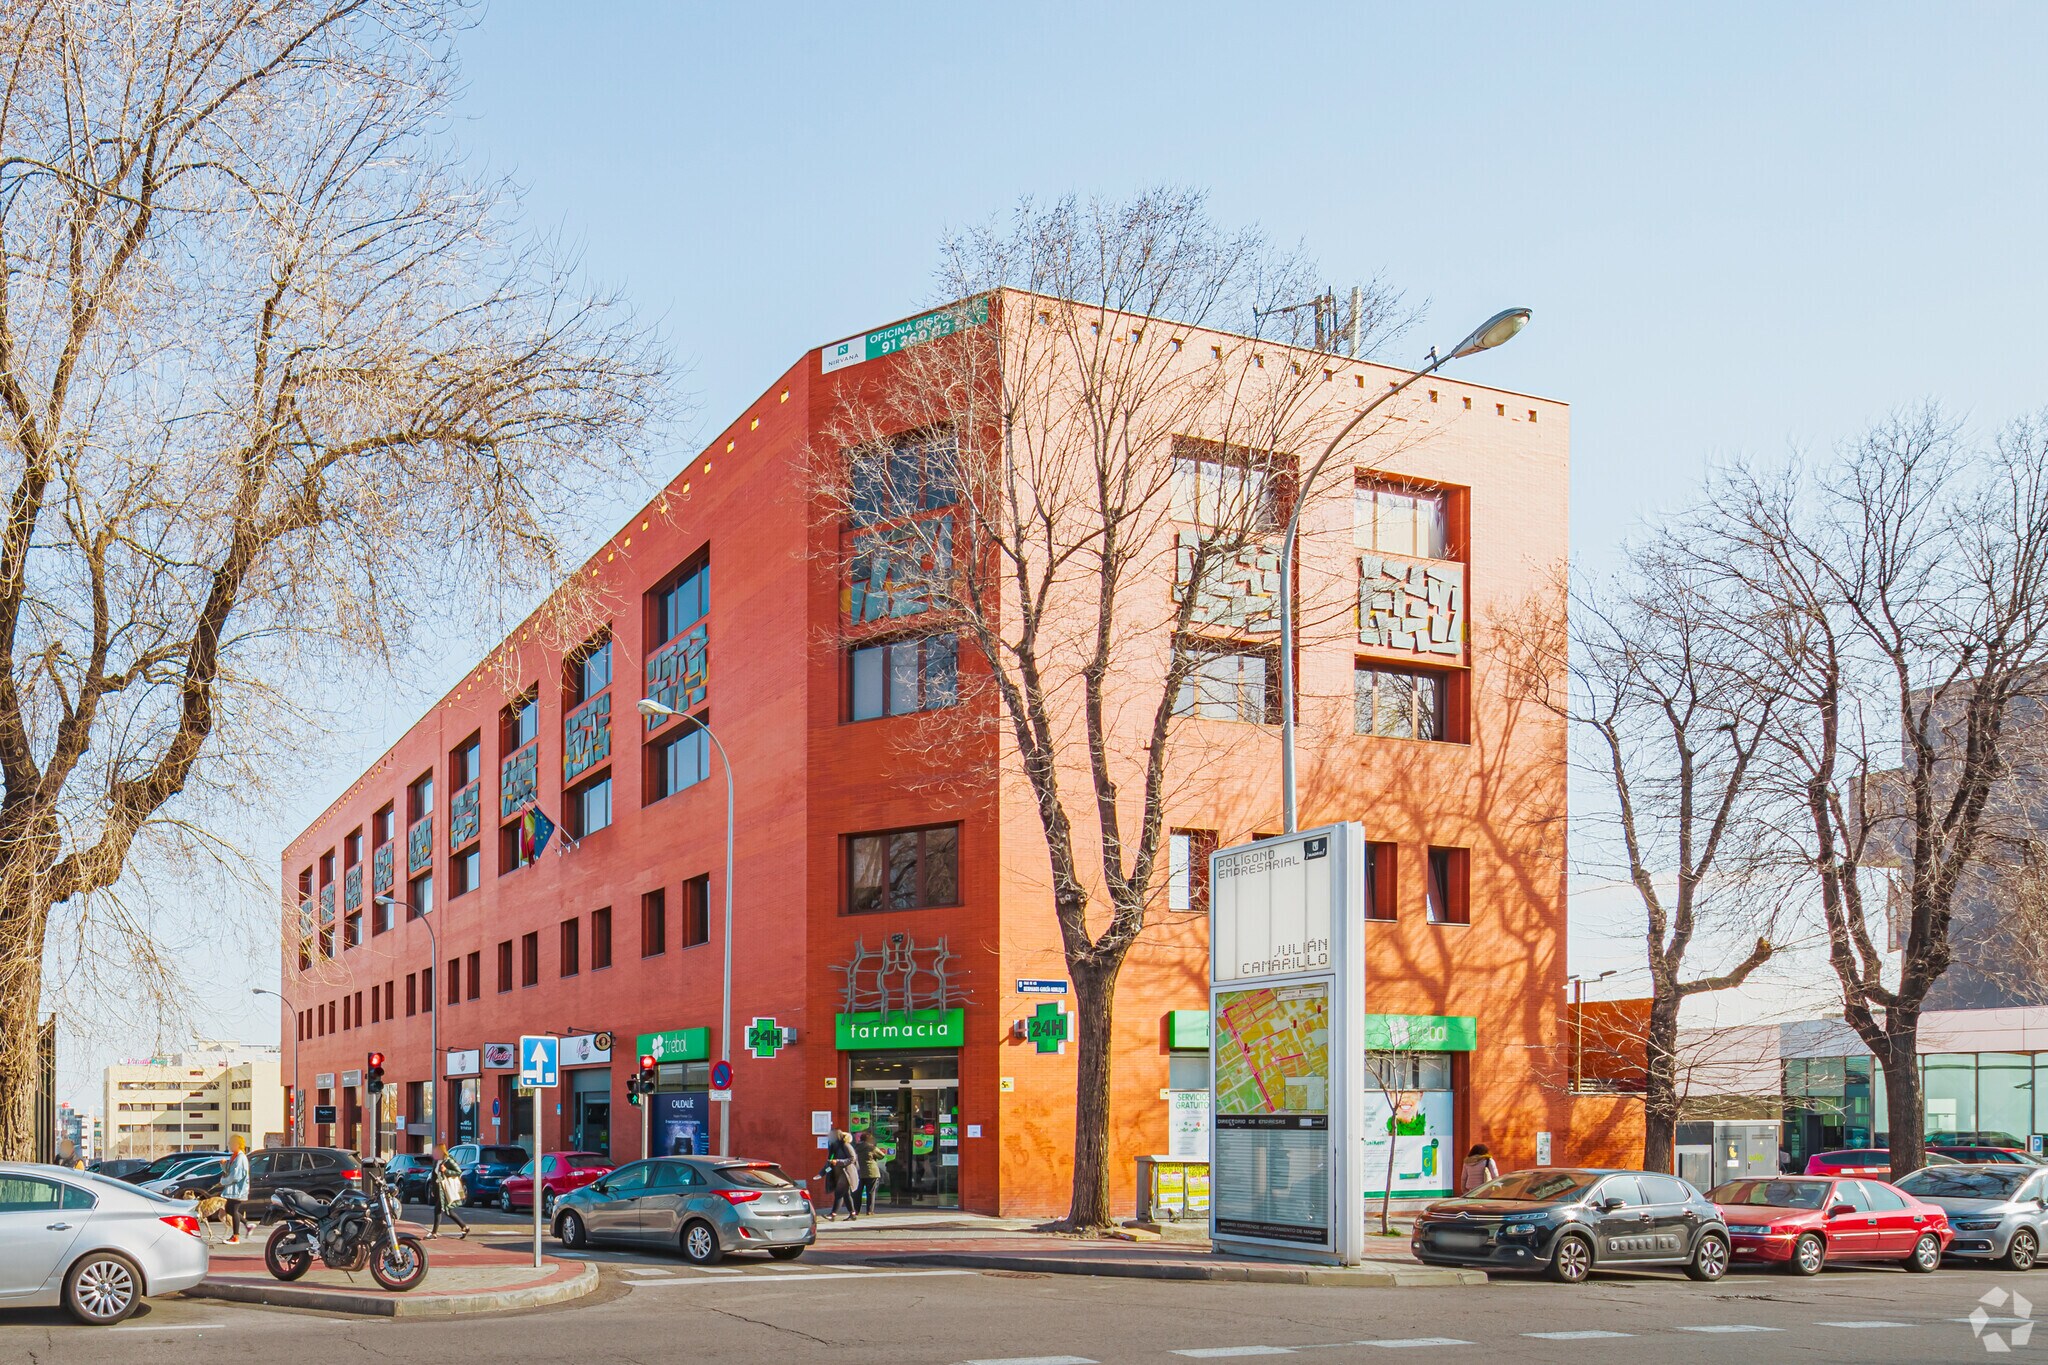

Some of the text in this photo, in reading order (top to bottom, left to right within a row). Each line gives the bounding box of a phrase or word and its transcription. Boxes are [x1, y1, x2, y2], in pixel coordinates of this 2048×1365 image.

[869, 324, 913, 344] OFICINA
[881, 338, 896, 353] 91
[828, 353, 859, 366] NIRVANA
[1218, 856, 1300, 879] EMPRESARIAL
[1274, 938, 1328, 957] JULIÁN
[1242, 953, 1328, 974] CAMARILLO
[850, 1022, 948, 1038] farmacia
[1032, 1018, 1064, 1037] 24H
[750, 1030, 780, 1046] 24H
[1176, 1101, 1209, 1109] GRATUITO
[2034, 1138, 2040, 1150] P
